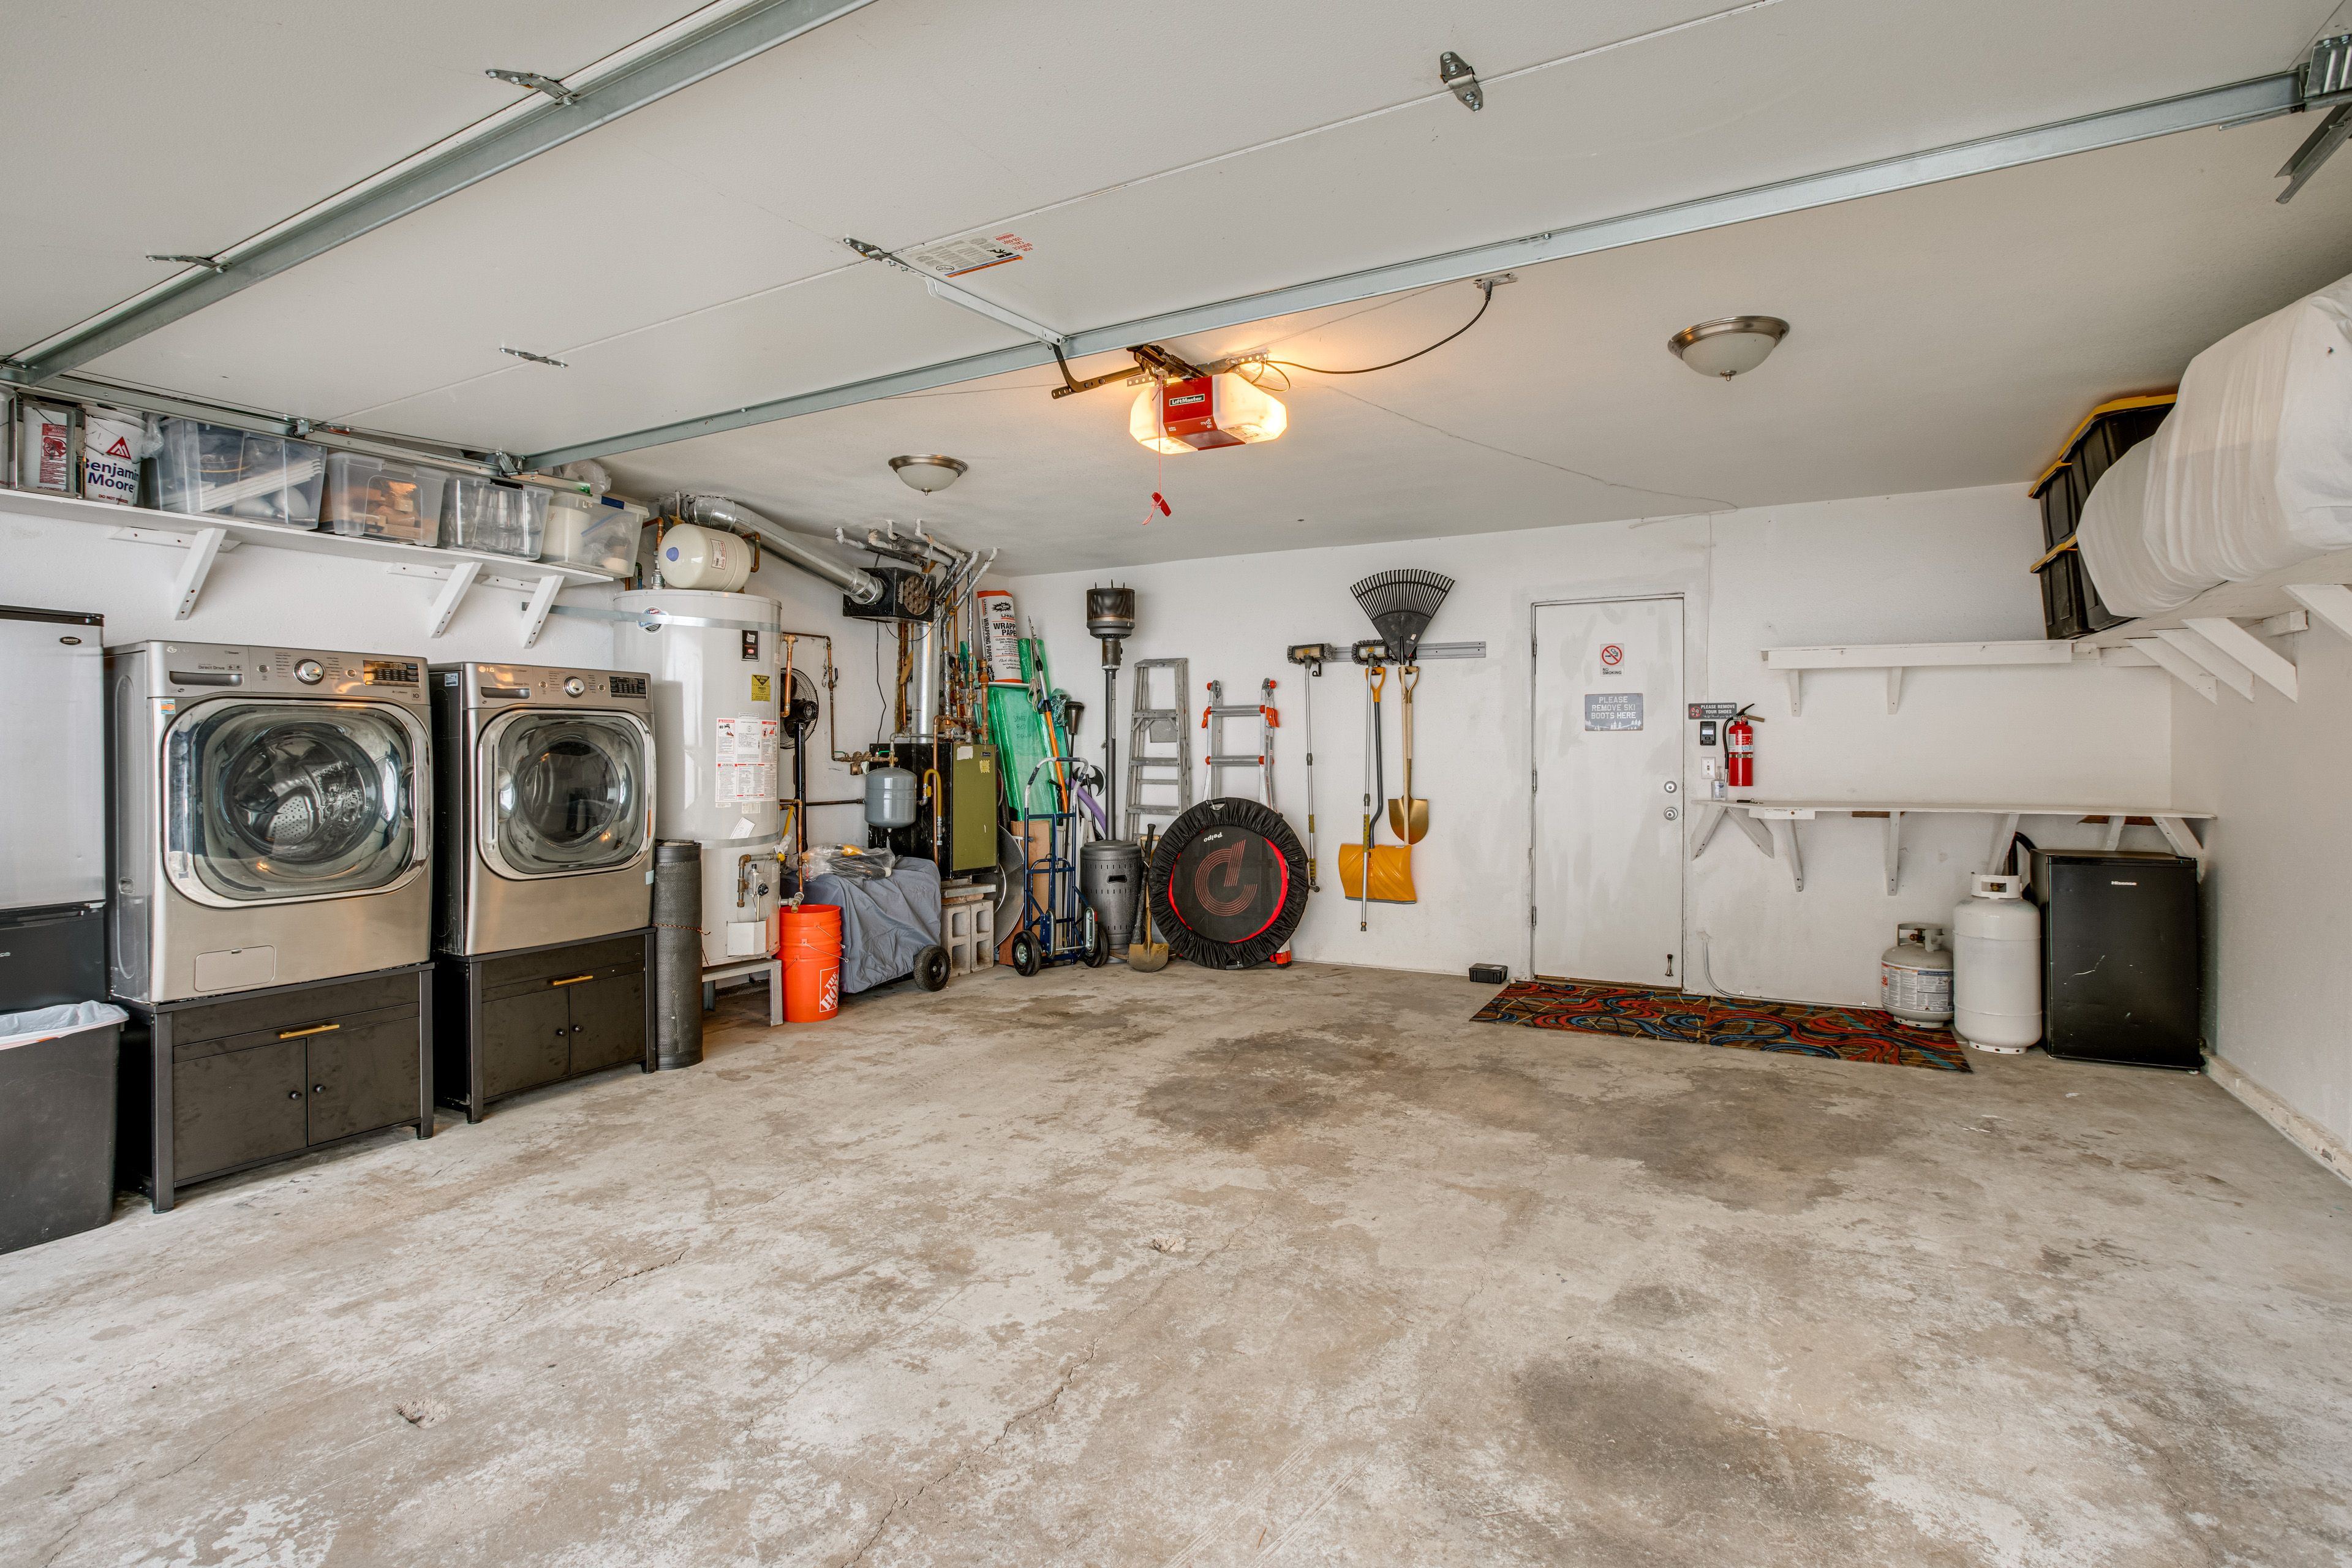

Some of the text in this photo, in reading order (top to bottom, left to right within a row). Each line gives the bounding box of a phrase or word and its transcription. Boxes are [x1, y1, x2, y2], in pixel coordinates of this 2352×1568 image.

[1172, 396, 1202, 405] LiftMaster
[88, 472, 134, 493] Moore
[1204, 832, 1223, 842] Pelpo
[824, 971, 837, 990] THE
